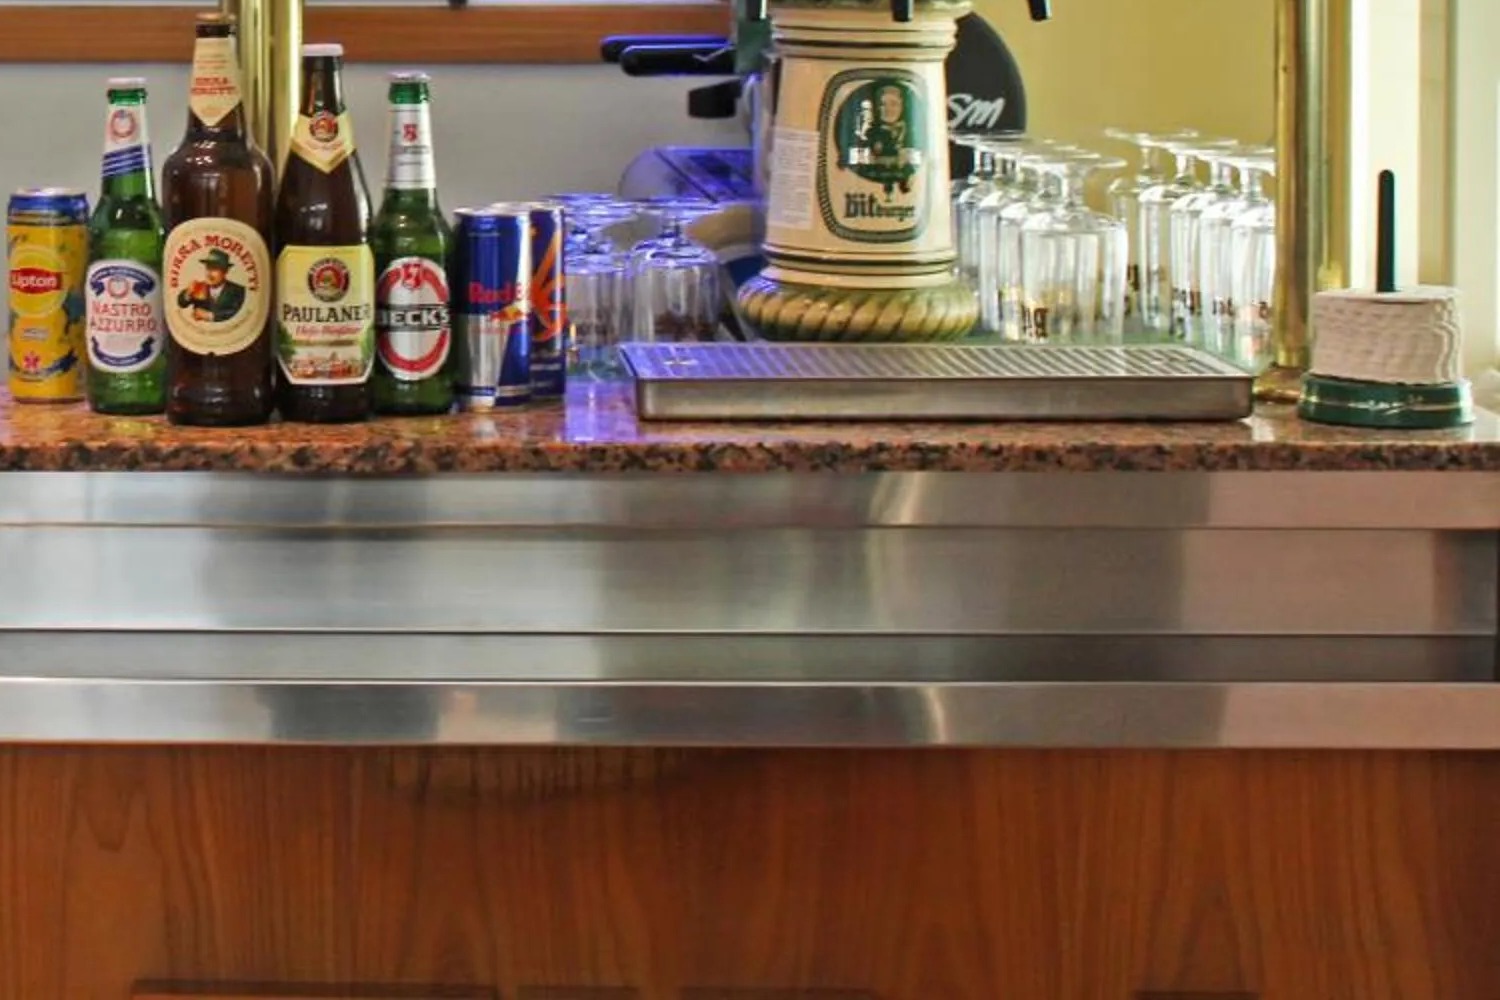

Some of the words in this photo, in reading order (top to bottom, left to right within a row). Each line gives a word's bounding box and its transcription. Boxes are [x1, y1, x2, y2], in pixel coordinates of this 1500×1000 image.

[11, 274, 58, 290] Lipton
[92, 301, 152, 316] NASTRO
[282, 304, 372, 322] PAULANER
[90, 316, 158, 332] AZZURRO
